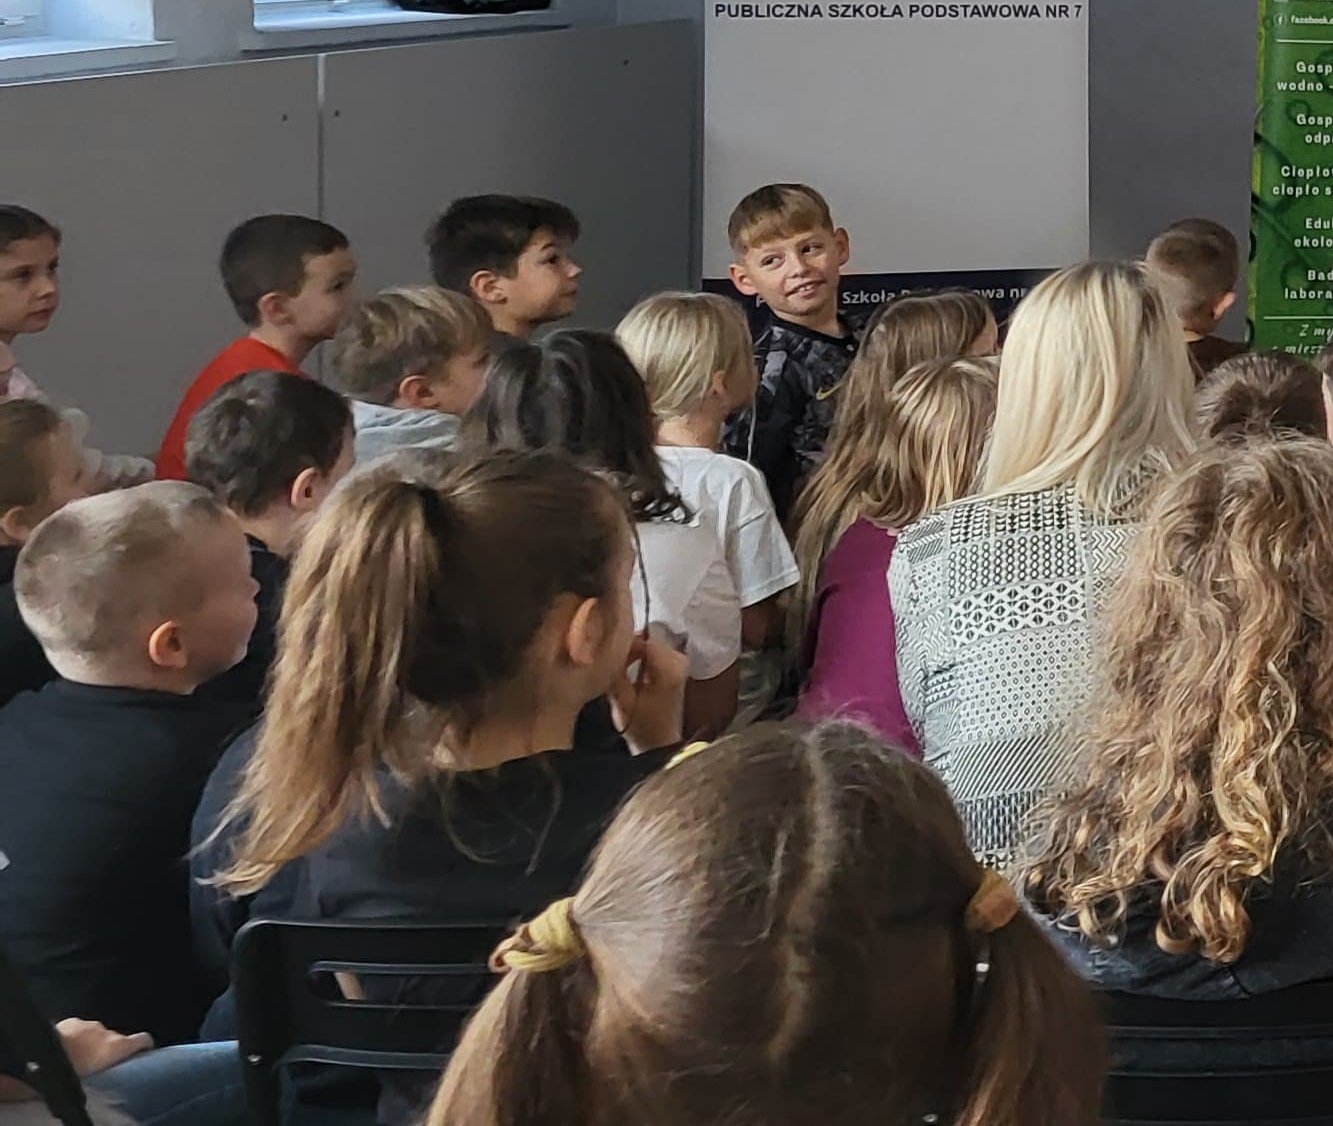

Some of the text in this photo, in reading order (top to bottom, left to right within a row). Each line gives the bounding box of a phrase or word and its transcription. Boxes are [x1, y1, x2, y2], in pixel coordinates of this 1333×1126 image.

[714, 4, 1083, 19] PUBLICZNA SZKOŁA PODSTAWOWA NR 7
[1277, 78, 1324, 91] wodno
[842, 290, 897, 305] Szkoła
